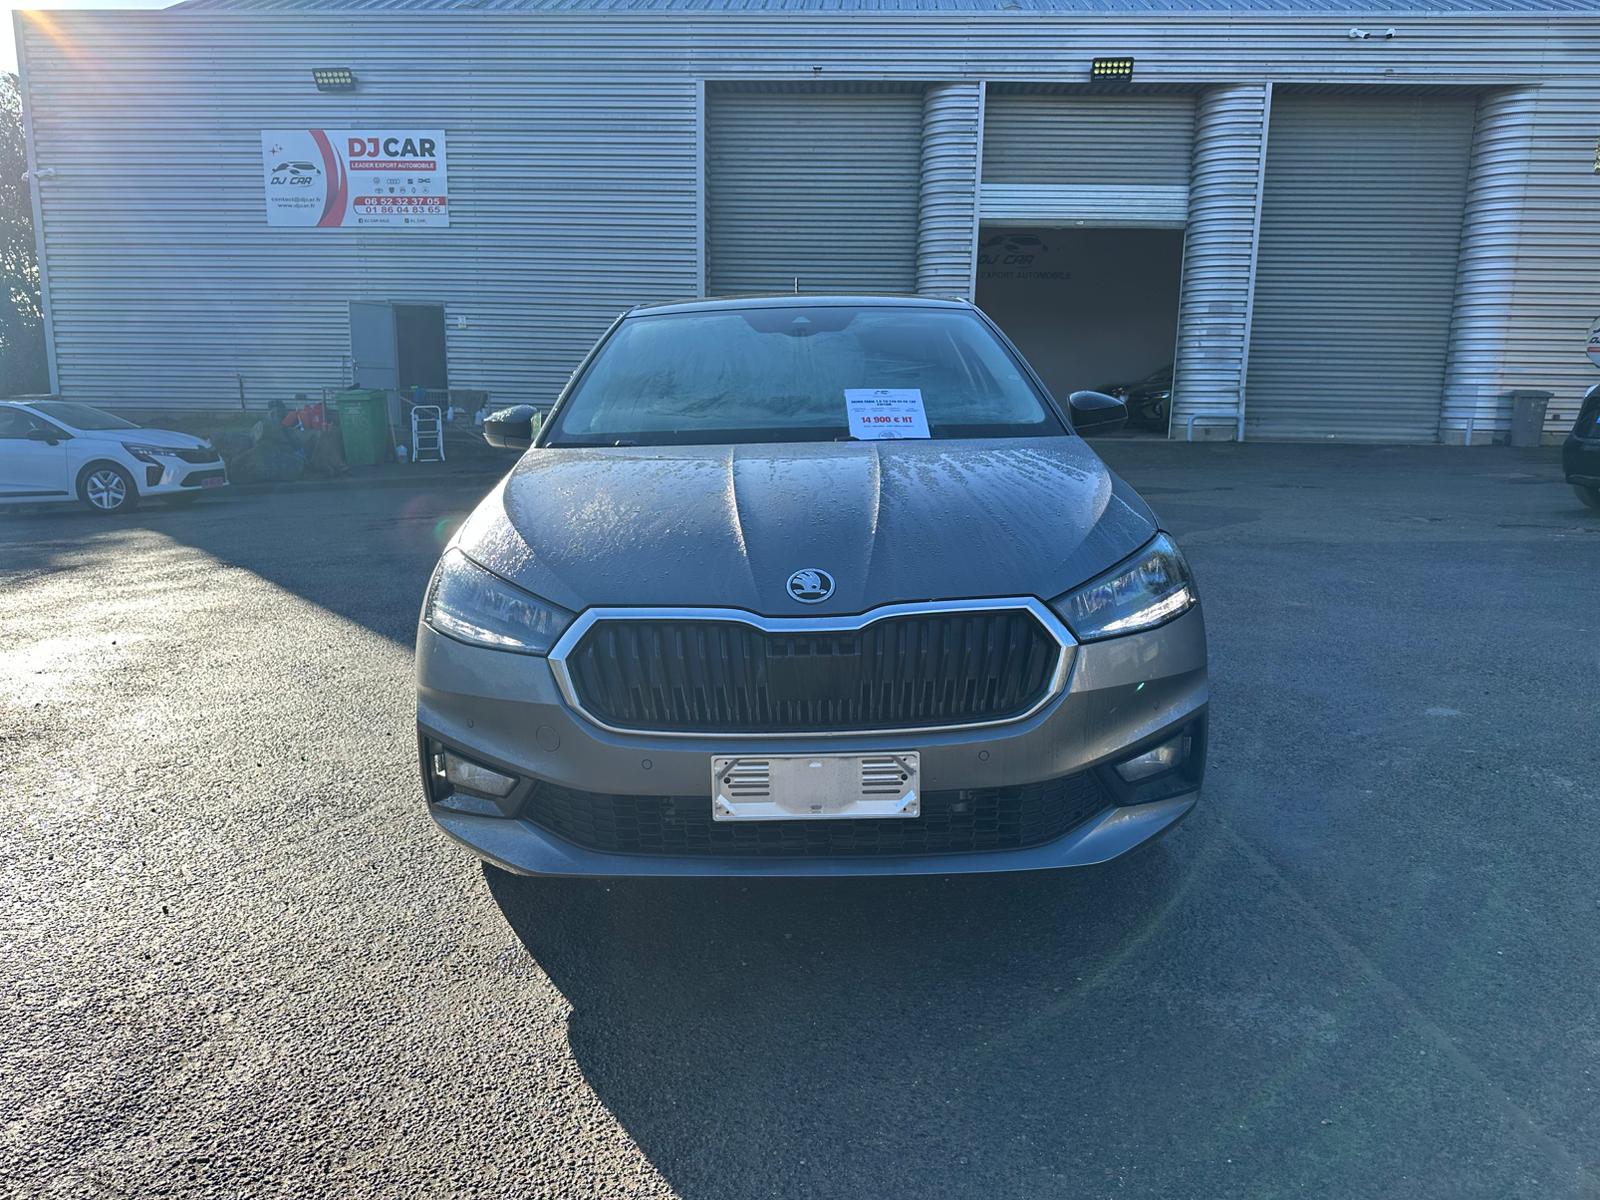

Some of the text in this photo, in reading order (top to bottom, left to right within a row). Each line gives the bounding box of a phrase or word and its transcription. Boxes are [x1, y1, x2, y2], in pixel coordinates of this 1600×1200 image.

[348, 137, 436, 157] DJ CAR
[271, 177, 313, 185] DJ CAR
[364, 197, 440, 205] 06 52 32 37 05
[1003, 254, 1034, 265] CAR
